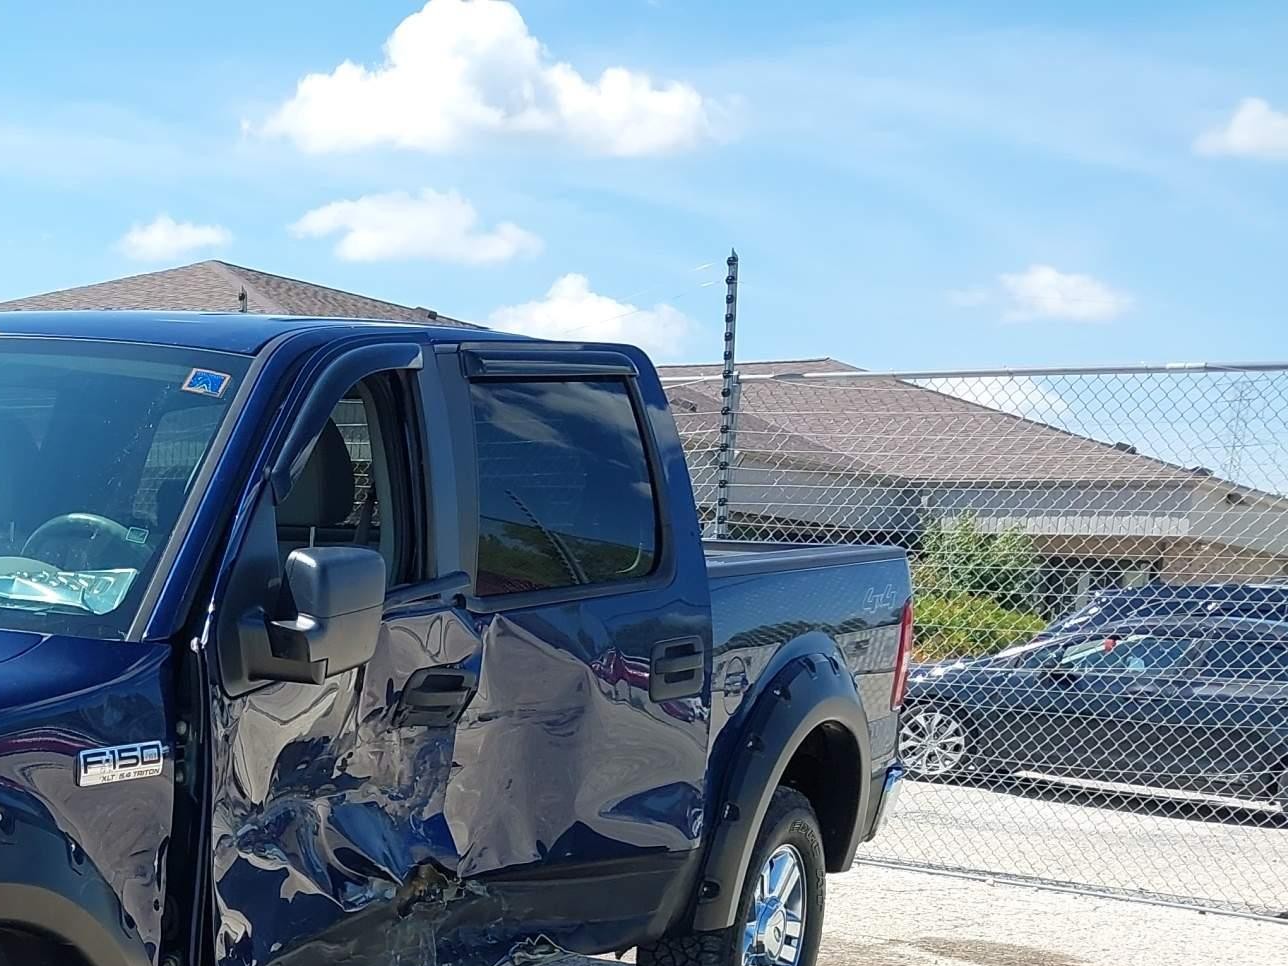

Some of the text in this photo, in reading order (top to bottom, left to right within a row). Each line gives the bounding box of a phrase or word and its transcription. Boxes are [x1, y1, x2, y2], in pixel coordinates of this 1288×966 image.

[101, 774, 116, 783] XLT
[132, 768, 160, 778] TRITON
[788, 820, 822, 858] EDGE
